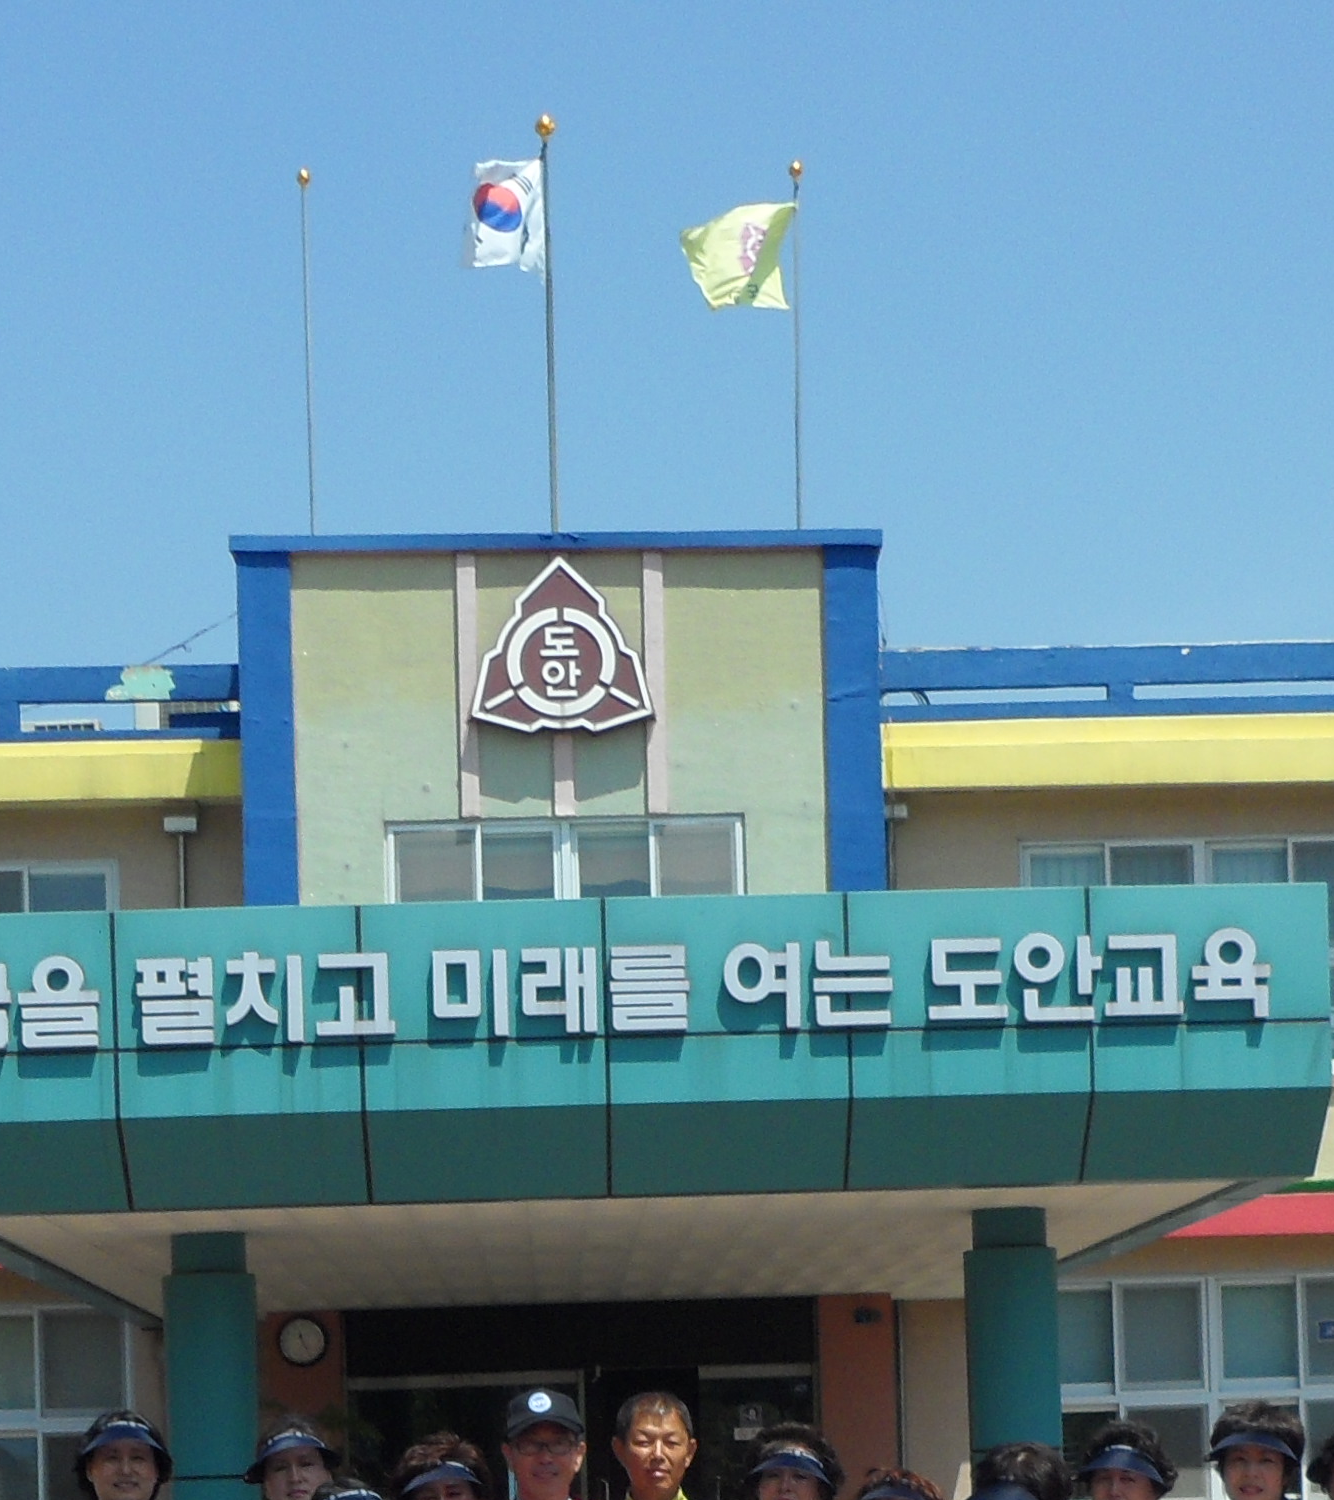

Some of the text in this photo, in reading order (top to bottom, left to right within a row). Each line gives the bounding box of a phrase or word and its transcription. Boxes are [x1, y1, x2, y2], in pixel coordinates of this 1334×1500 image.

[540, 627, 582, 697] 도안
[134, 950, 397, 1046] 펼치고
[430, 943, 692, 1036] 미래를
[722, 938, 895, 1028] 여는
[927, 925, 1273, 1023] 도안교육
